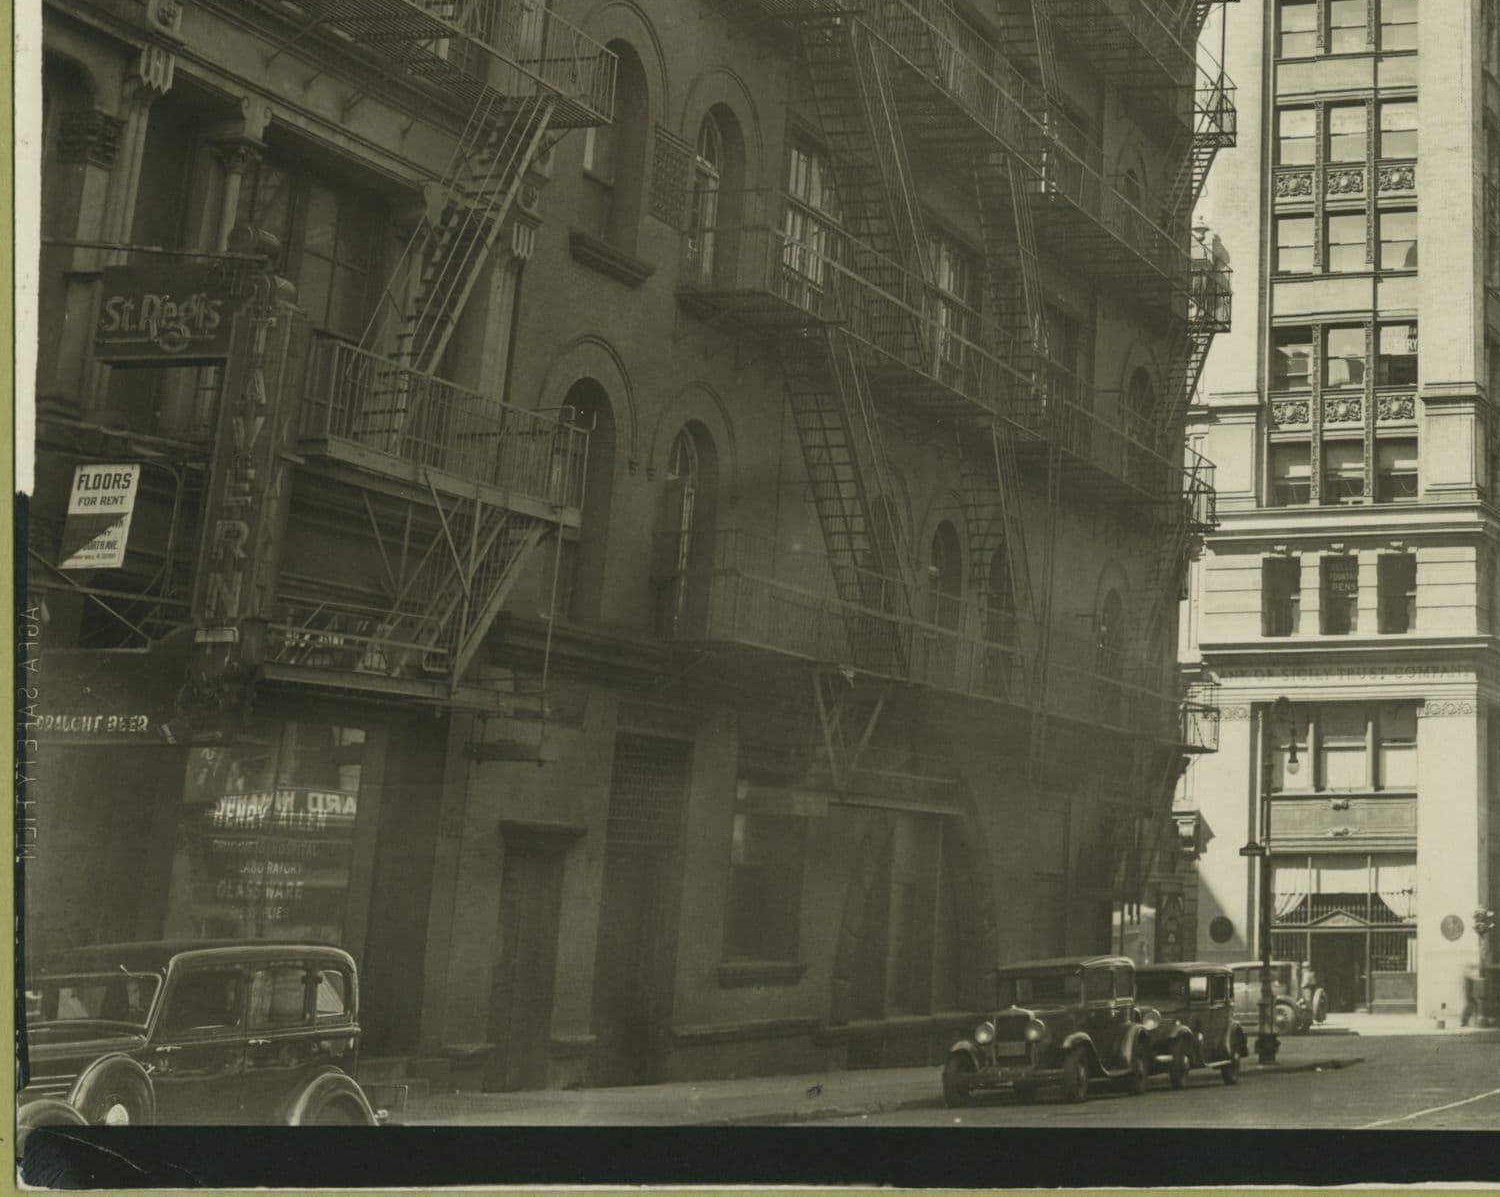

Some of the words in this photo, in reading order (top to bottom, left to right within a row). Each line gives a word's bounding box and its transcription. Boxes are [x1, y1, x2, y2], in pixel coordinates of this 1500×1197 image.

[139, 293, 223, 353] Regis
[205, 315, 278, 619] TAVERN
[77, 472, 132, 491] FLOORS
[78, 496, 98, 507] FOR
[99, 495, 126, 507] RENT
[1219, 669, 1248, 682] ANK
[1251, 668, 1277, 682] OF
[1281, 667, 1332, 682] SICILY
[1335, 666, 1388, 681] TRUST
[1393, 664, 1472, 680] COMPANY
[106, 714, 149, 733] BEER
